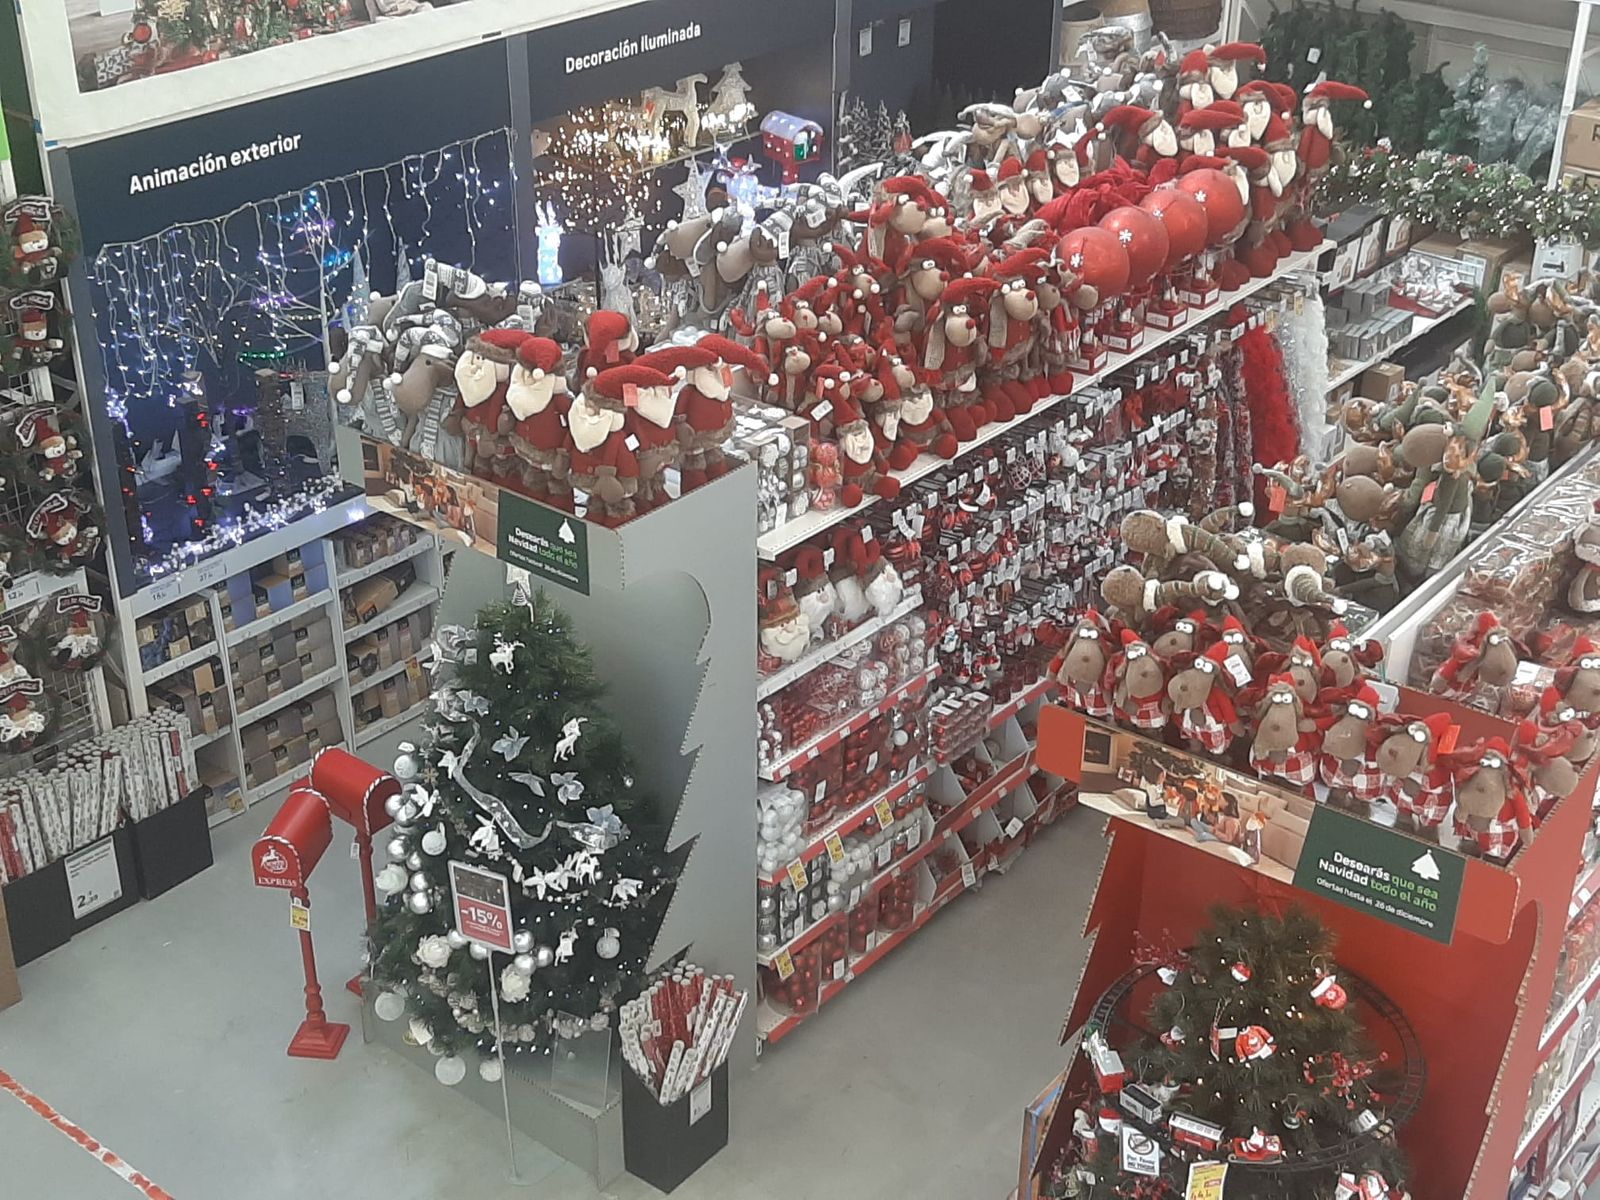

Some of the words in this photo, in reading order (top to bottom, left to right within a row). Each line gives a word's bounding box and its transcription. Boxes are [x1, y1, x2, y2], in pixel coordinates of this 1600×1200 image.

[565, 39, 638, 73] Decoración
[129, 153, 227, 195] Animación
[230, 134, 302, 167] exterior
[258, 876, 297, 887] EXPRESS
[1316, 877, 1344, 894] Ofertas
[1318, 858, 1369, 886] Navidad
[1370, 879, 1398, 897] todo
[1399, 890, 1411, 902] el
[1413, 896, 1437, 912] año
[1333, 851, 1391, 882] Desearás
[1391, 875, 1415, 891] que
[1417, 884, 1439, 900] sea
[461, 906, 503, 930] -15%
